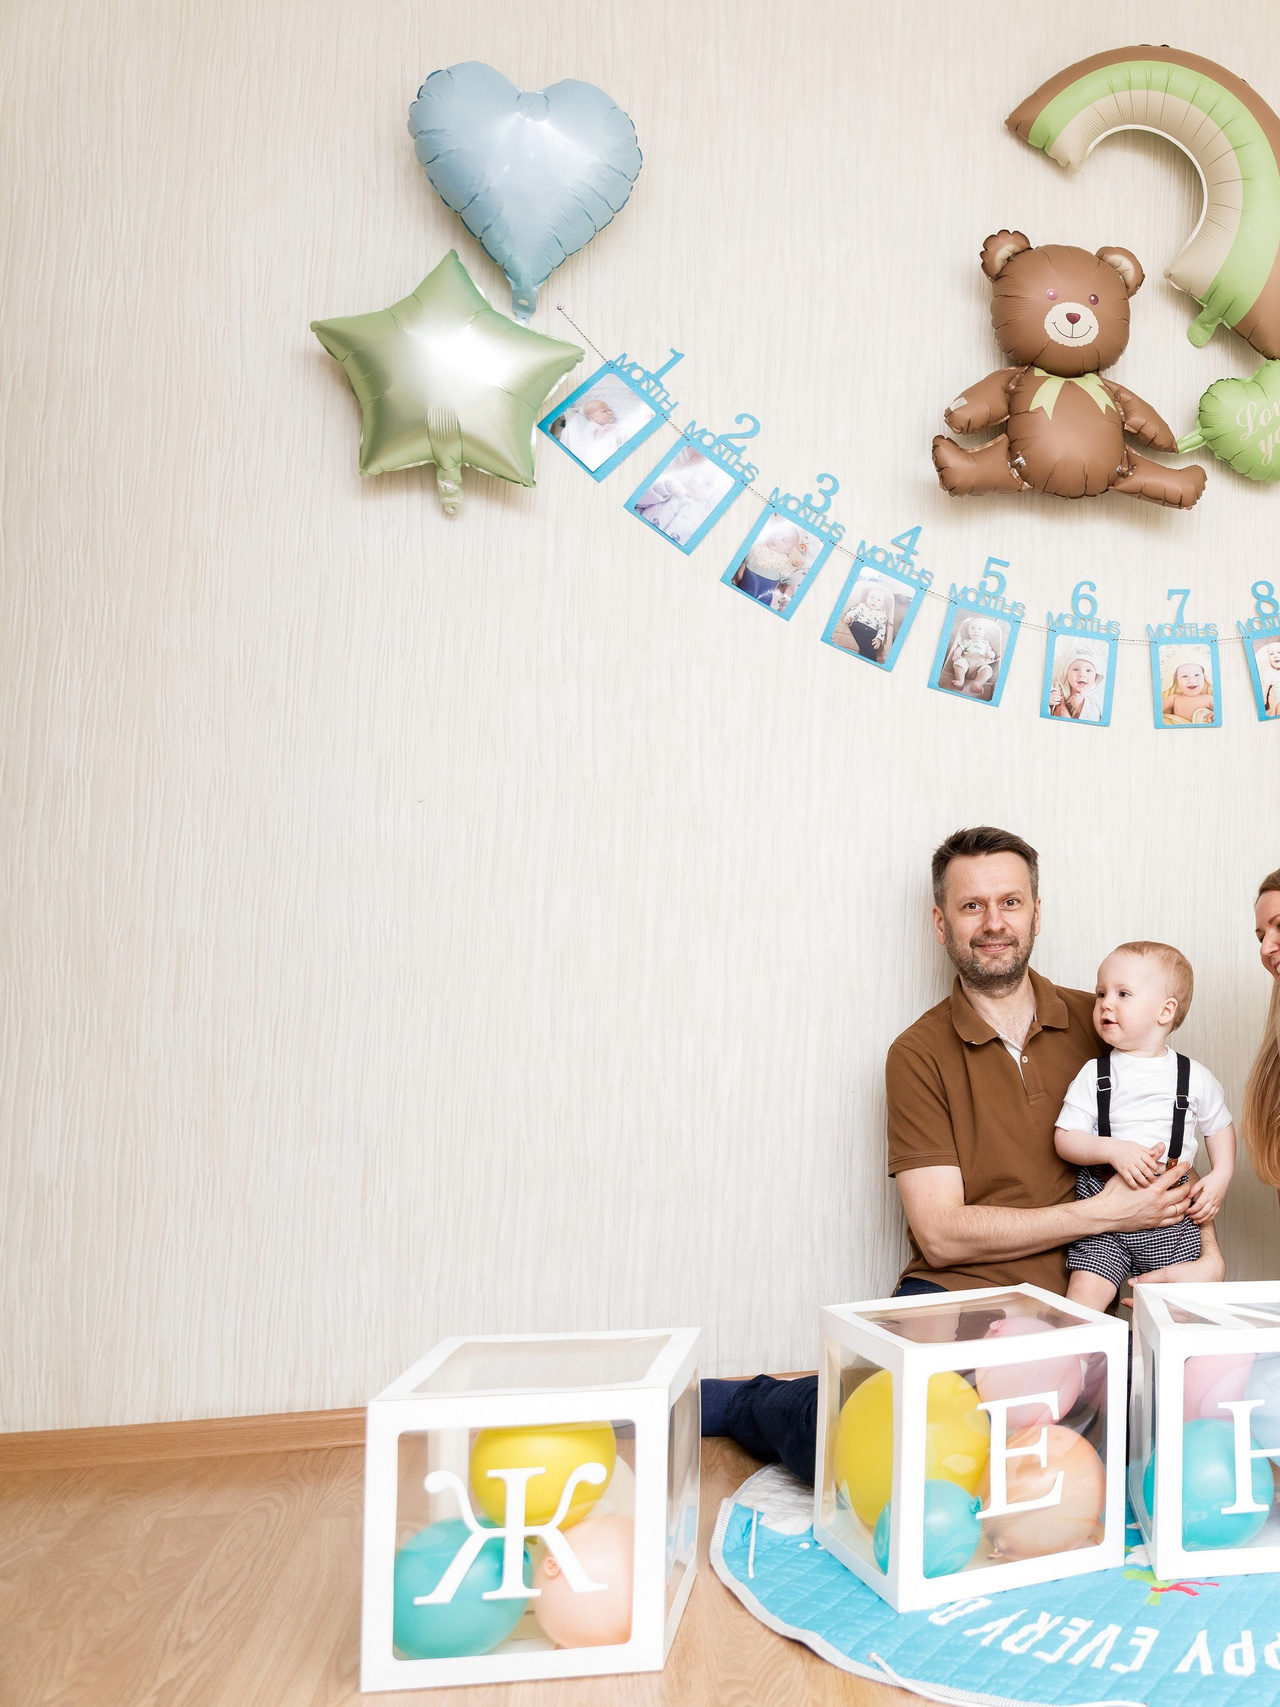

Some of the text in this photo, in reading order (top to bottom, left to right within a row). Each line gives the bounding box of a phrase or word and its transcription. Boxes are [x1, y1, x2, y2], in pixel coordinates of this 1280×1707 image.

[614, 352, 680, 413] MONTH
[650, 347, 686, 387] 1
[683, 419, 760, 483] MONTHS
[717, 412, 761, 457] 2
[768, 486, 847, 542] MONTHS
[803, 472, 841, 515] 3
[856, 539, 935, 588] MONTHS
[891, 525, 923, 562] 4
[978, 556, 1011, 598] 5
[948, 582, 1027, 618] MONTHS
[1071, 580, 1098, 620] 6
[1166, 588, 1191, 627] 7
[1250, 580, 1280, 618] 8
[1045, 610, 1122, 636] MONTHS
[1146, 622, 1220, 639] MONTHS
[413, 1462, 609, 1606] Ж
[962, 1608, 1160, 1674] EVERY
